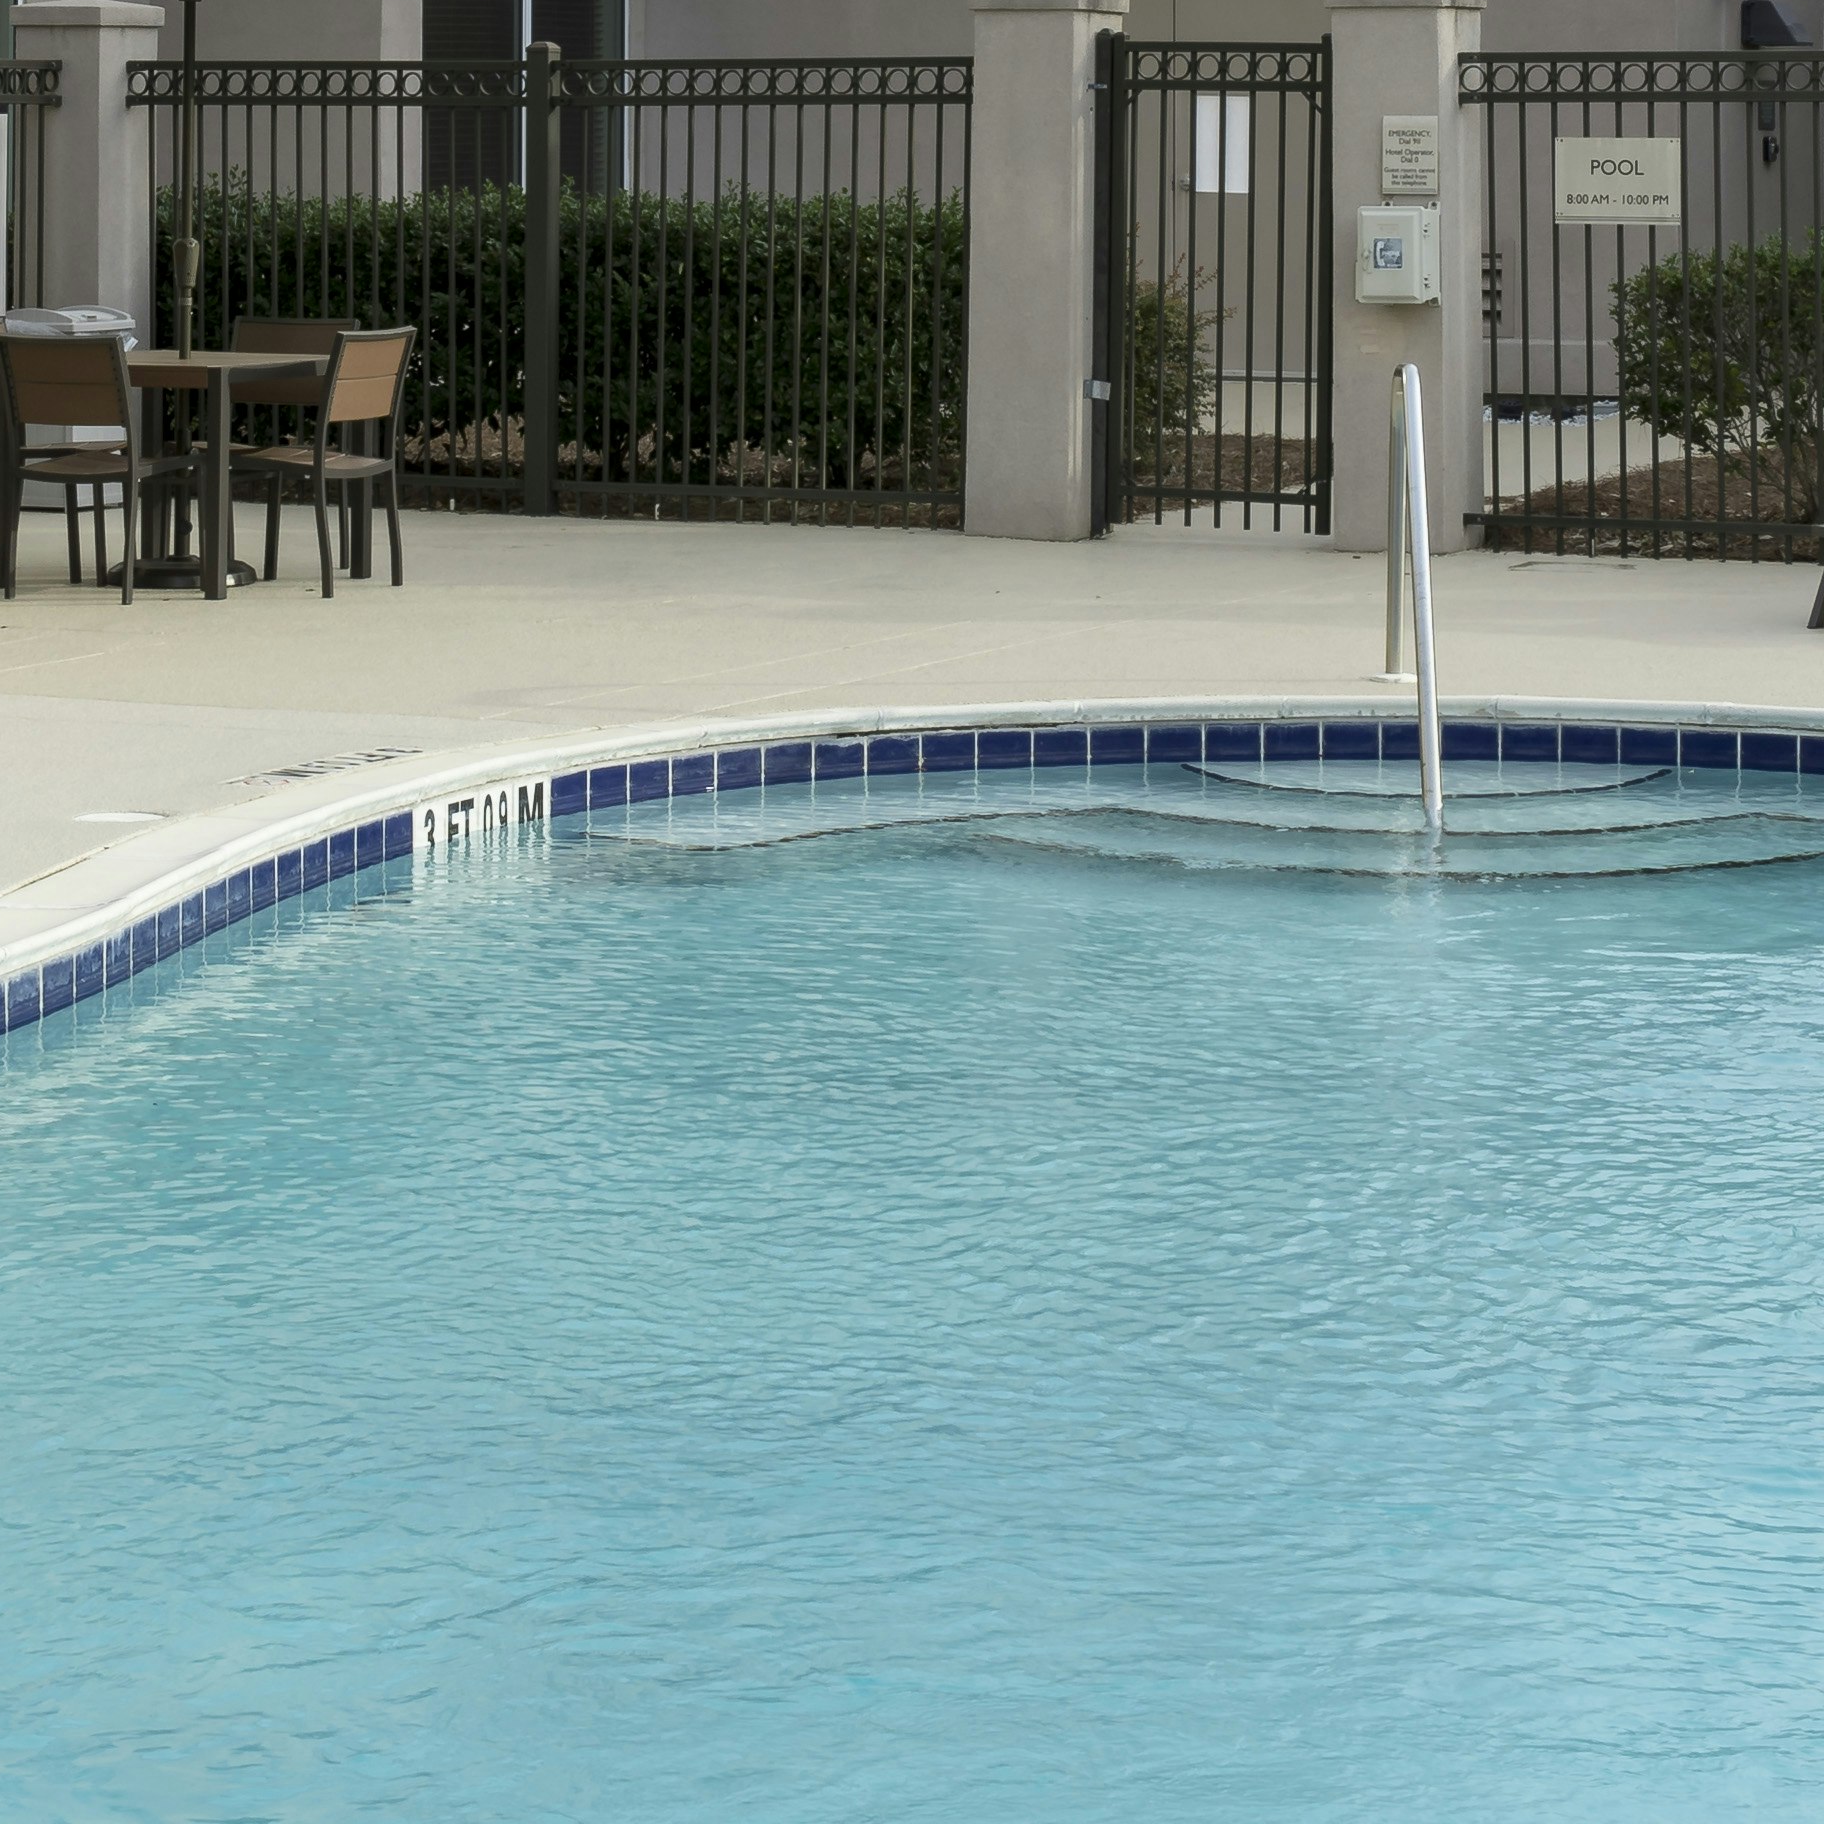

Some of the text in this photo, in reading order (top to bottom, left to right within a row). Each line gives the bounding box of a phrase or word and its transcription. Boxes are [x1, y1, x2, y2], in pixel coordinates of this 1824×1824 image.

[1590, 159, 1645, 176] POOL
[1566, 193, 1589, 205] 8:00
[1591, 194, 1610, 205] AM
[1622, 194, 1650, 205] 10:00
[1652, 194, 1669, 206] PM
[447, 797, 475, 844] FT
[518, 781, 544, 825] M
